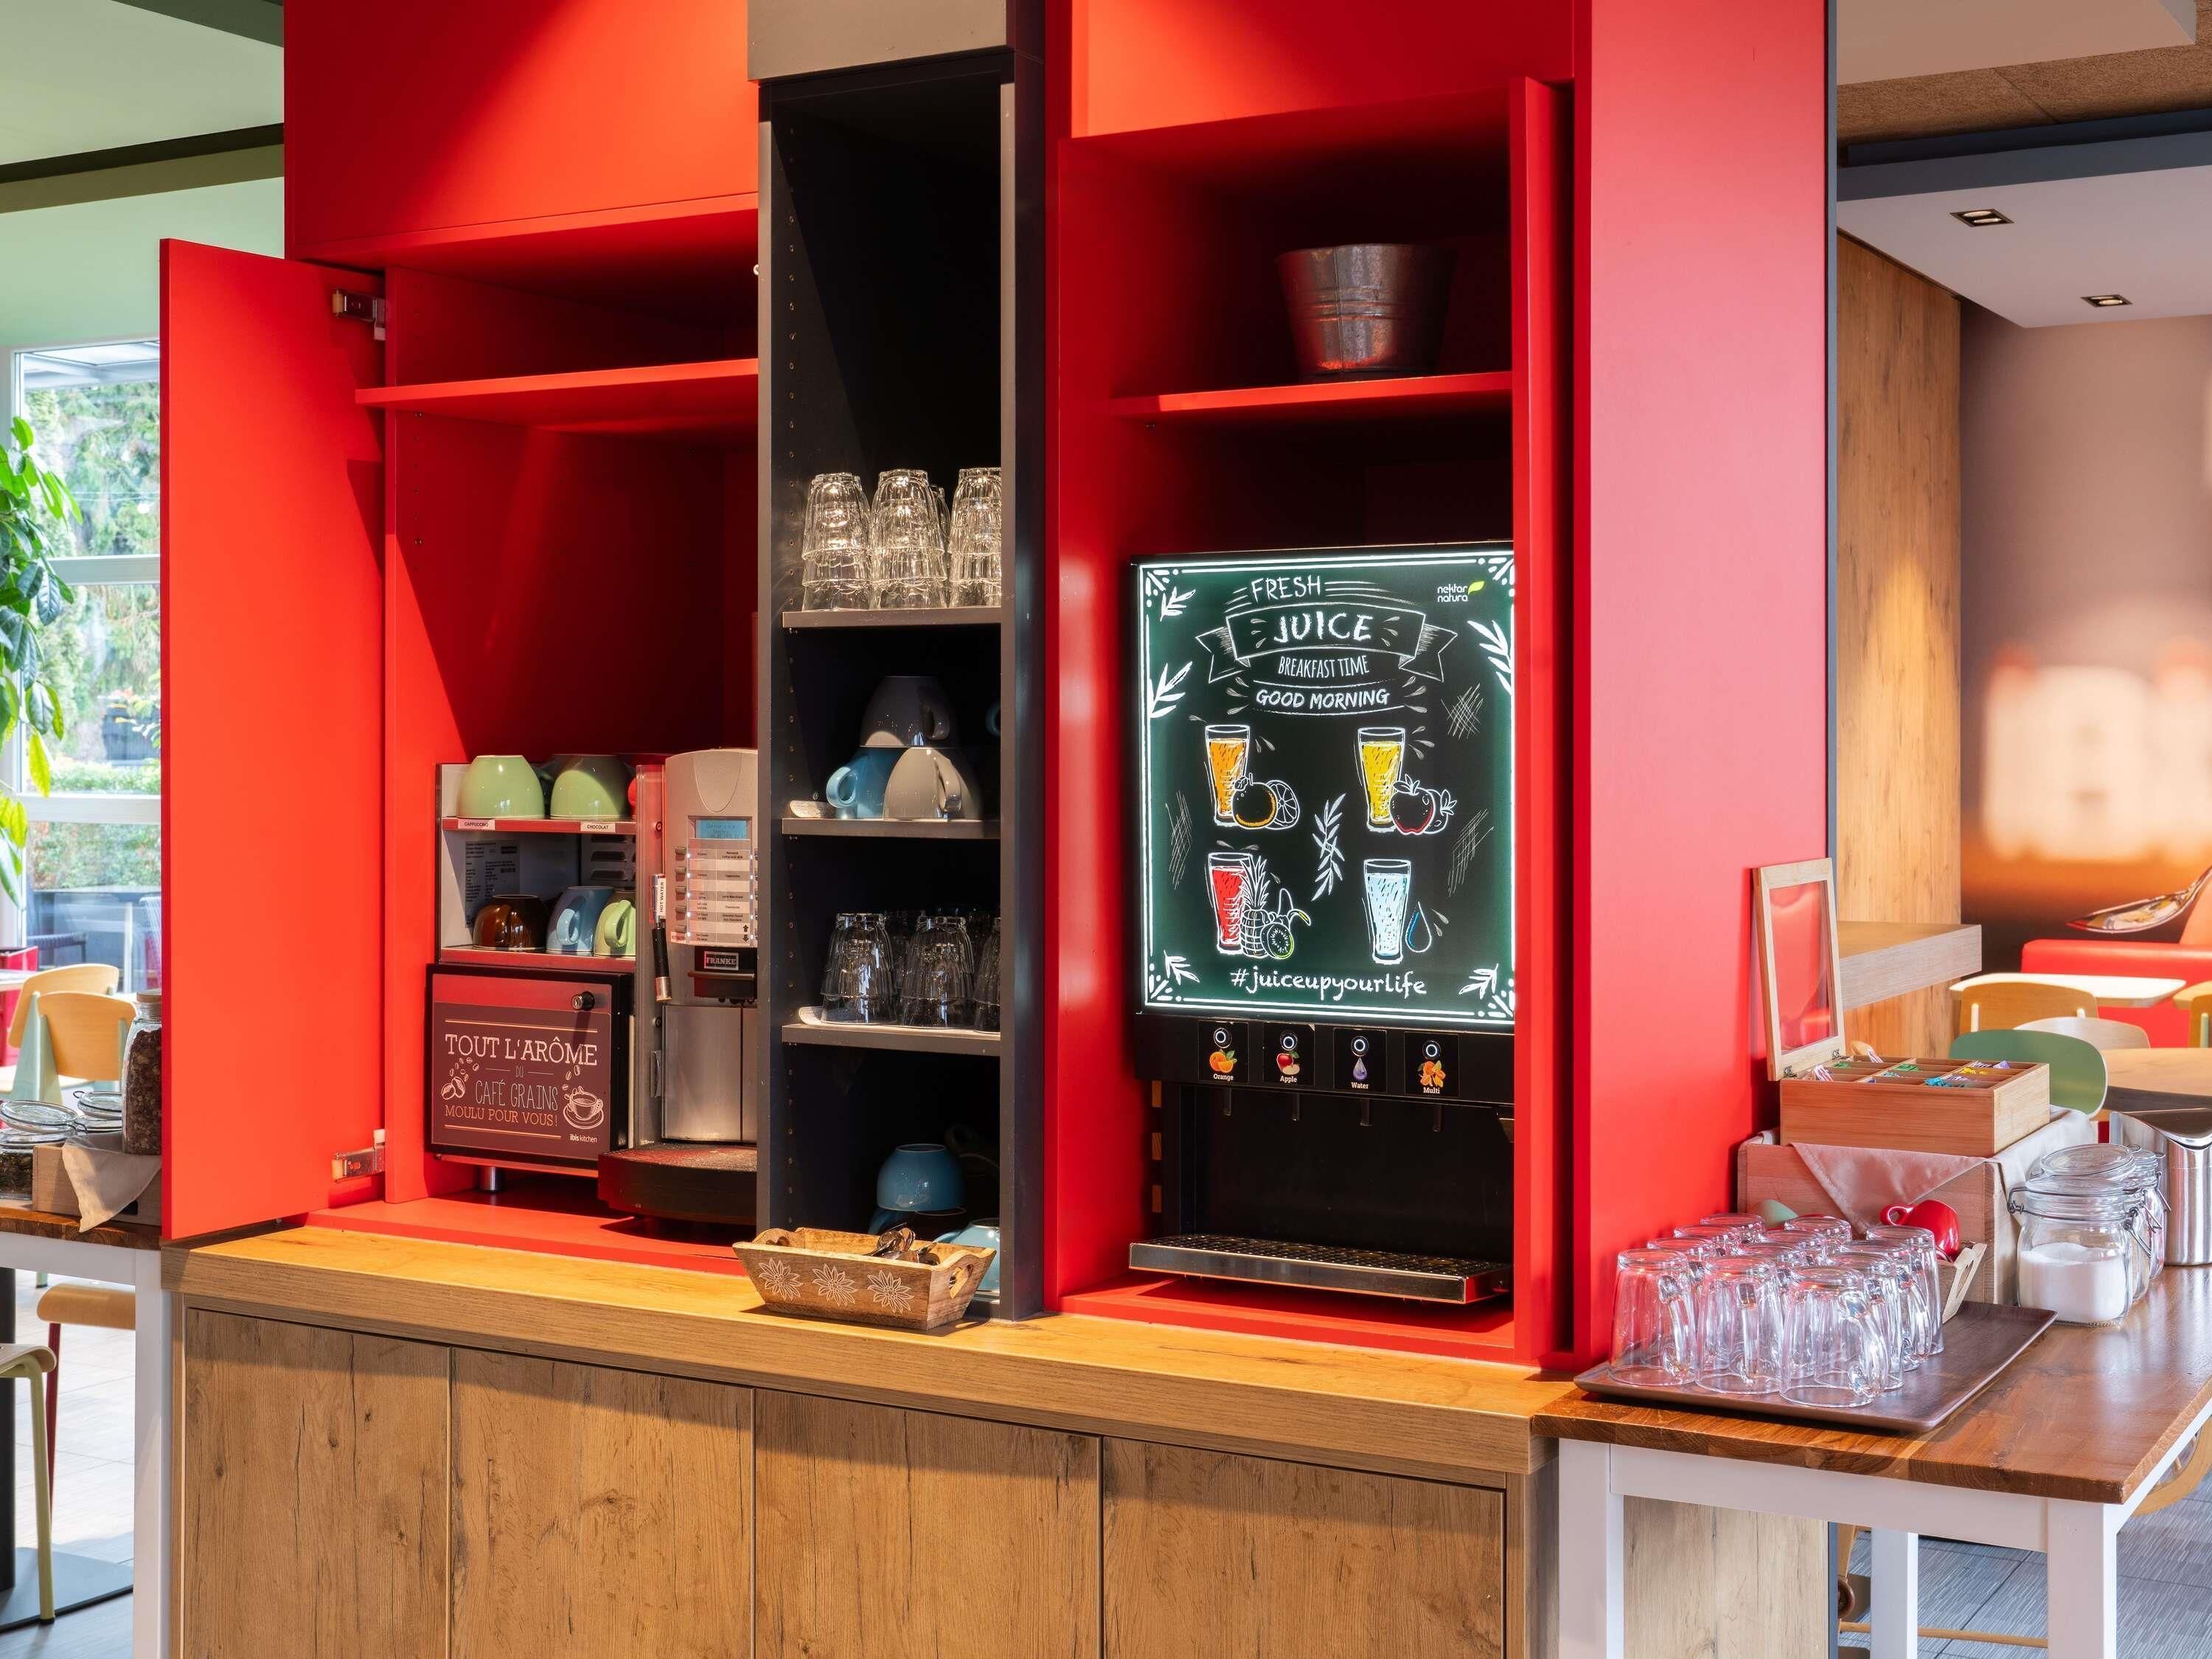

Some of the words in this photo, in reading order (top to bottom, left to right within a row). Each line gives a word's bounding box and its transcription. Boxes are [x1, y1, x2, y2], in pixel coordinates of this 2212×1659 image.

[1251, 577, 1321, 602] FRESH
[1437, 584, 1468, 594] nektar
[1437, 594, 1468, 602] natura
[1274, 612, 1374, 643] JUICE
[1278, 655, 1335, 678] BREAKFAST
[1338, 655, 1369, 676] TIME
[1256, 689, 1305, 708] GOOD
[1310, 689, 1390, 710] MORNING
[706, 957, 736, 965] FRANKE
[1230, 965, 1427, 1001] #juiceupyourlife
[445, 1034, 499, 1059] TOUT
[504, 1037, 597, 1066] L'ARÔME
[515, 1065, 524, 1078] DU
[1213, 1074, 1234, 1082] Orange
[1280, 1075, 1298, 1084] Apple
[1351, 1082, 1369, 1090] Water
[475, 1079, 506, 1107] CAFÉ
[510, 1082, 558, 1111] GRAINS
[1423, 1087, 1440, 1095] Multi
[445, 1105, 484, 1121] MOULU
[488, 1107, 518, 1124] POUR
[569, 1133, 580, 1142] ibis
[580, 1134, 598, 1144] kitchen
